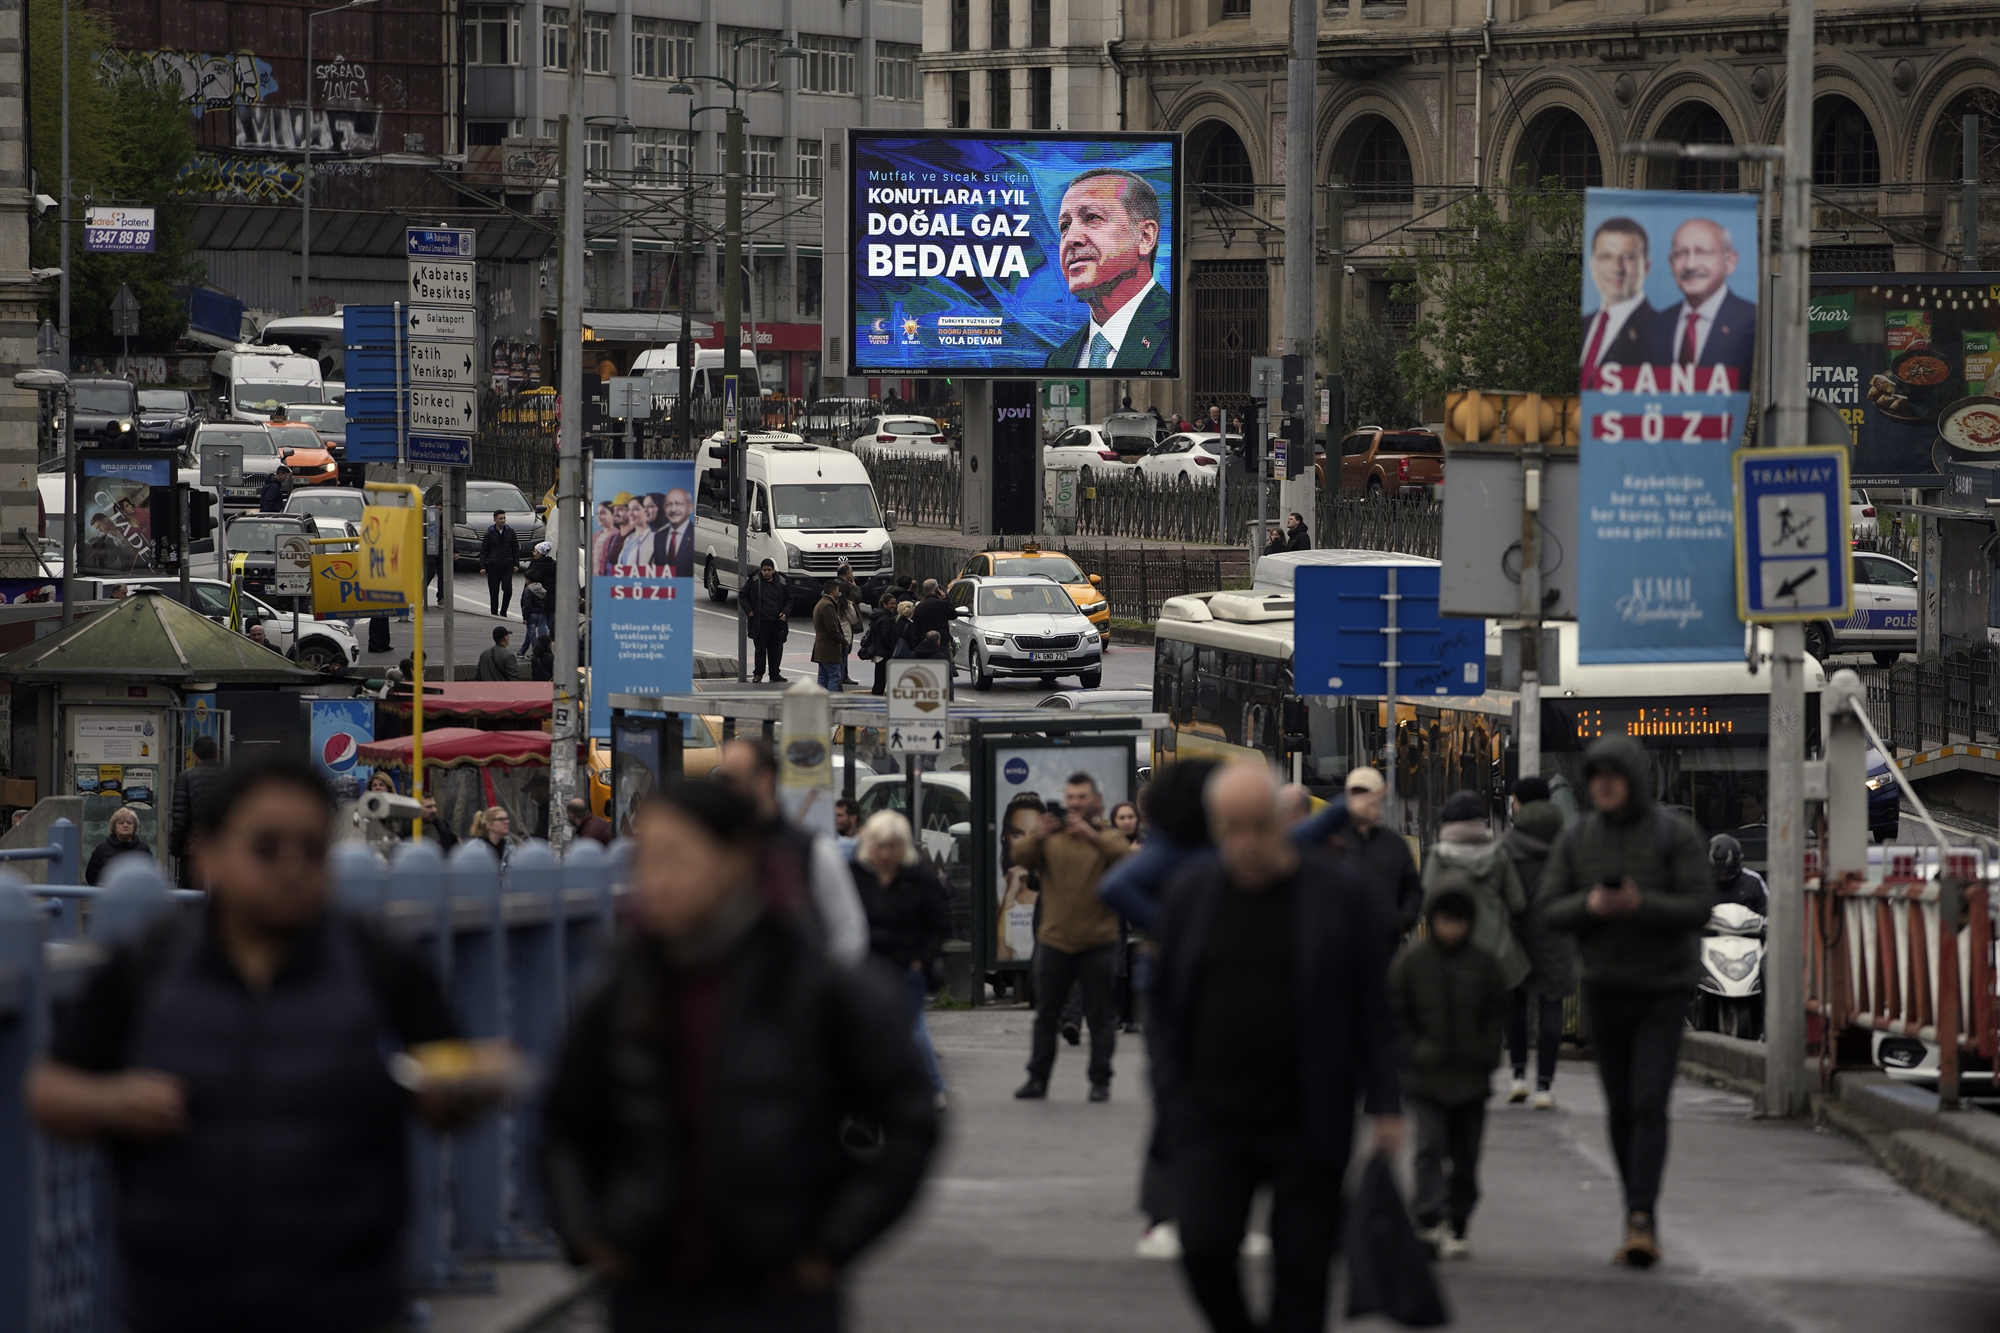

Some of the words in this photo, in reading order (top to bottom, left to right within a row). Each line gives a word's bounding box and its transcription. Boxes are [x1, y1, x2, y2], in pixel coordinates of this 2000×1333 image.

[316, 64, 366, 79] SPREAD
[869, 171, 915, 181] Mutfak
[922, 174, 936, 182] ve
[943, 172, 978, 182] sıcak
[984, 174, 998, 182] su
[1005, 172, 1029, 184] için
[868, 188, 984, 204] KONUTLARA
[988, 190, 996, 204] 1
[1000, 190, 1029, 205] YIL
[92, 218, 115, 226] adres
[122, 219, 149, 227] patent
[868, 209, 965, 236] DOĞAL
[971, 214, 1030, 236] GAZ
[96, 230, 117, 243] 347
[119, 231, 134, 244] 89
[135, 231, 150, 244] 89
[868, 244, 1030, 277] BEDAVA
[421, 266, 468, 283] Kabataş
[422, 284, 470, 301] Beşiktaş
[427, 314, 464, 325] Galataport
[1807, 305, 1850, 322] Knorr
[967, 337, 1002, 345] DEVAM
[411, 346, 440, 359] Fatih
[413, 364, 456, 381] Yenikapı
[1601, 362, 1732, 397] SANA
[1807, 362, 1858, 382] İFTAR
[413, 392, 453, 408] Sirkeci
[413, 412, 459, 428] Unkapanı
[998, 403, 1030, 422] yovi
[1601, 402, 1729, 444] SÖZ!
[129, 463, 152, 471] prime
[1751, 466, 1832, 486] TRAMVAY
[279, 550, 313, 559] tune
[370, 547, 386, 578] Ptt
[614, 564, 673, 578] SANA
[340, 581, 363, 603] Pt
[614, 582, 672, 601] SÖZ!
[611, 623, 650, 632] Uzaklaşan
[652, 623, 673, 632] değil,
[1885, 613, 1917, 627] POLİS
[614, 633, 657, 641] kucaklaşan
[620, 642, 648, 650] Türkiye
[650, 642, 664, 650] için
[618, 651, 666, 660] çalışacağım.
[893, 688, 946, 699] tunel
